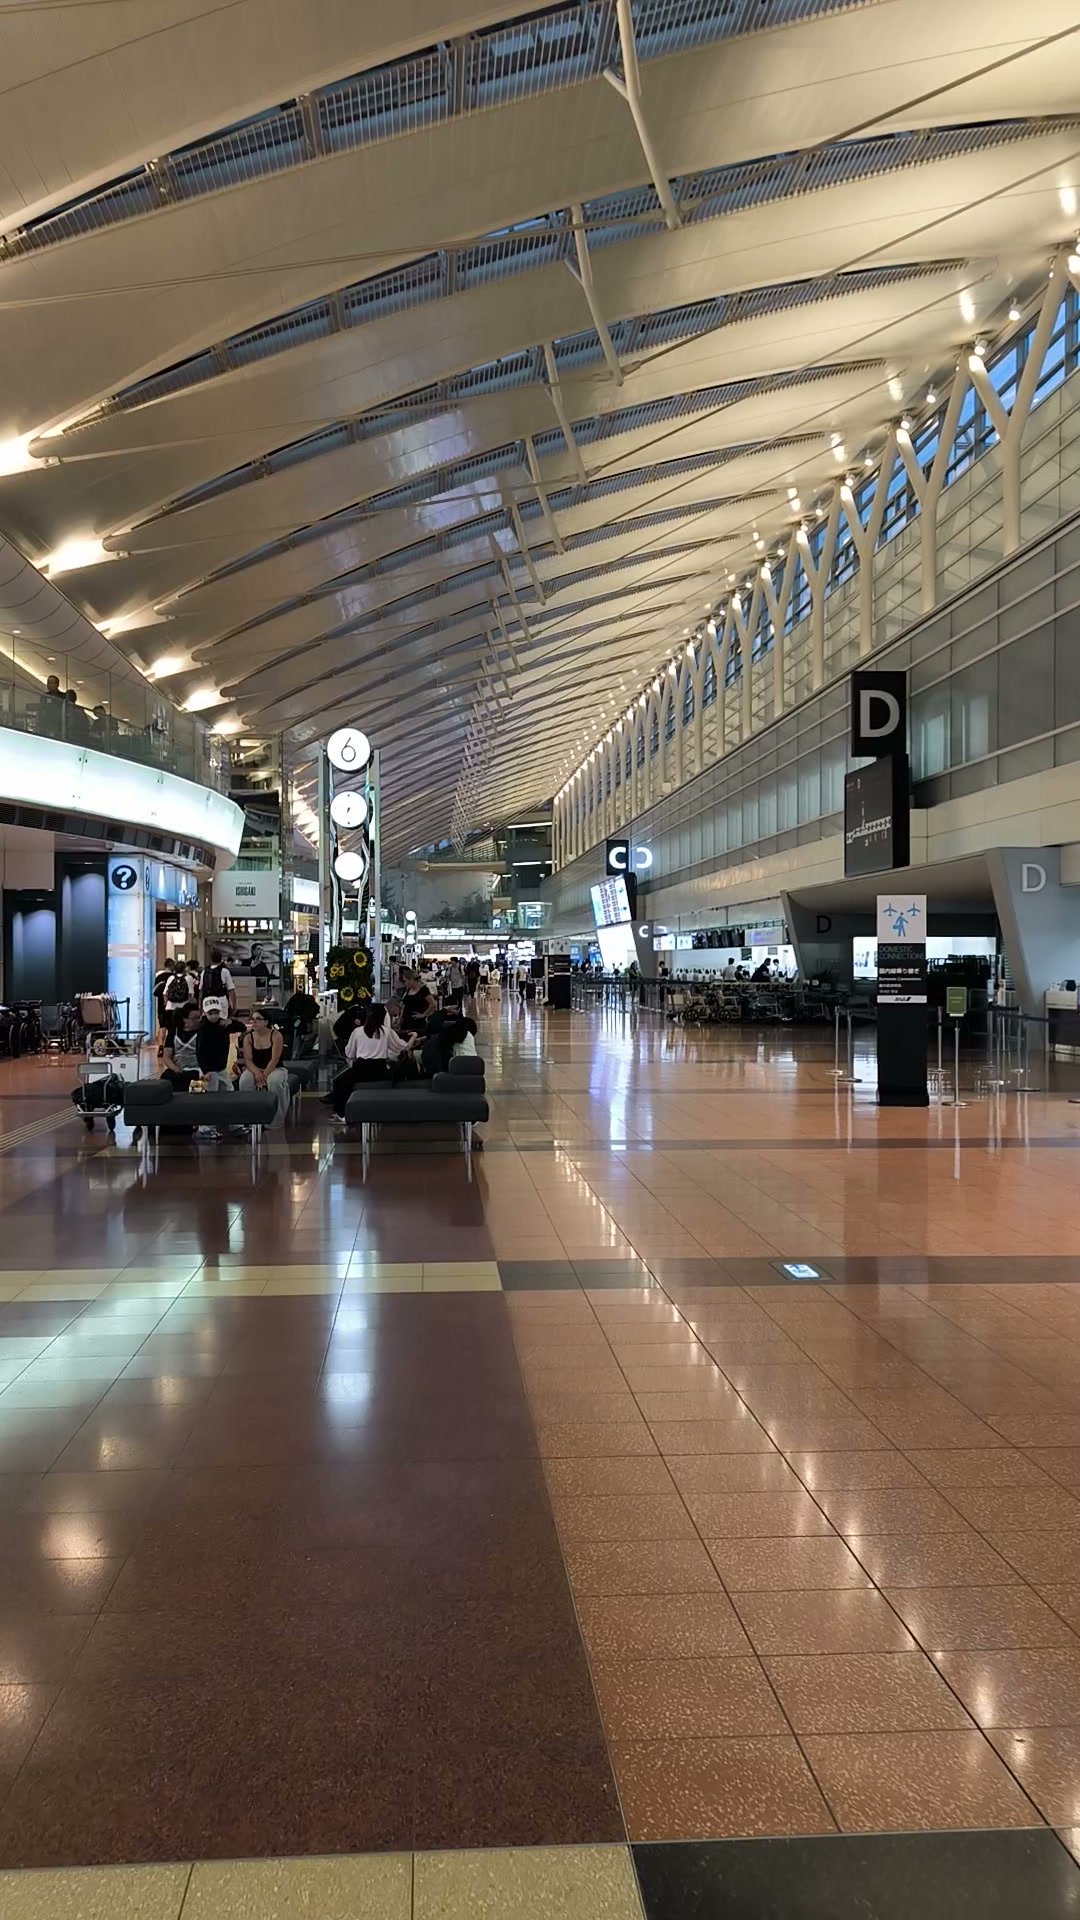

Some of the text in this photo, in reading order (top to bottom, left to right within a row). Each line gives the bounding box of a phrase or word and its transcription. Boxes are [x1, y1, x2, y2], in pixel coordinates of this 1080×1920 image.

[860, 690, 900, 738] D
[609, 847, 627, 869] C
[1022, 864, 1046, 892] D
[639, 925, 649, 938] C
[816, 915, 832, 933] D
